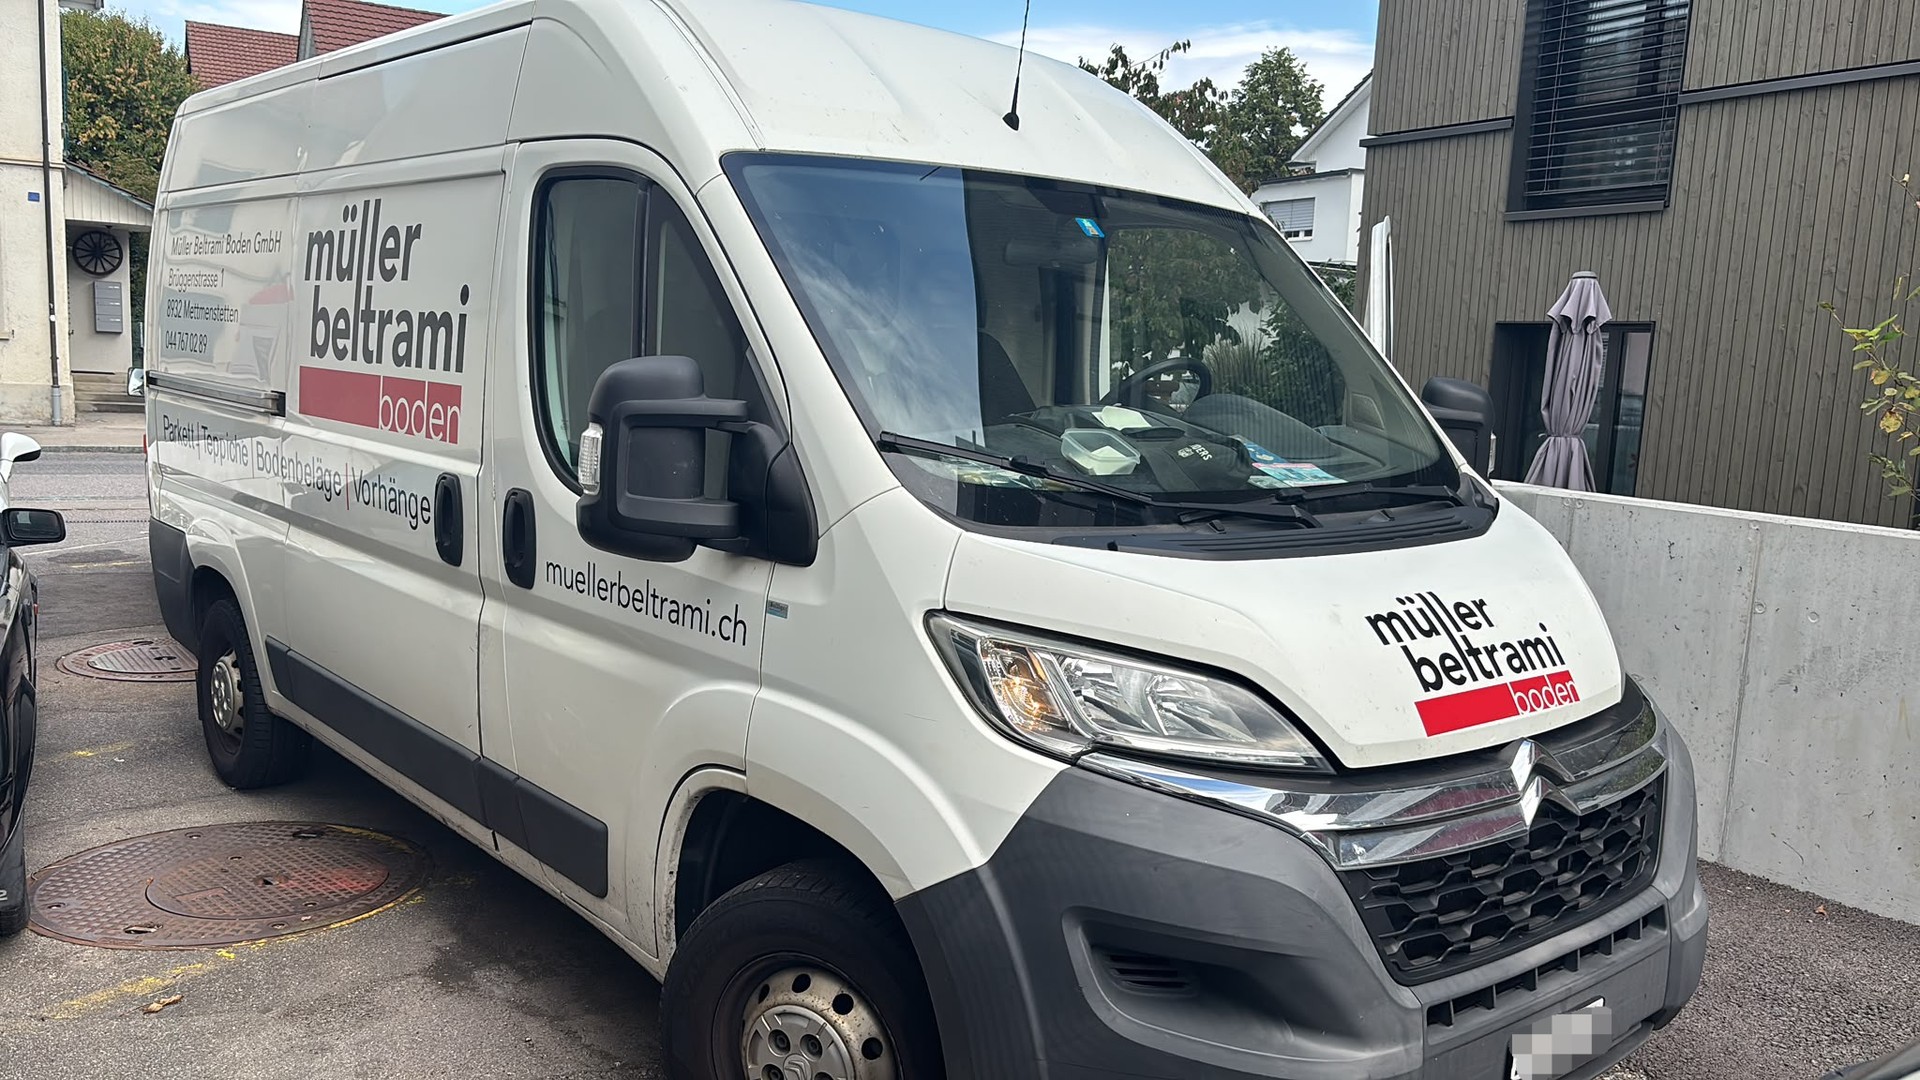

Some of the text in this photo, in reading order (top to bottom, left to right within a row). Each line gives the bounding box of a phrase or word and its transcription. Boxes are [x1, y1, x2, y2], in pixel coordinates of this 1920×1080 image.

[171, 230, 282, 255] Müller Beltrami Boden GmbH
[304, 199, 422, 282] müller
[166, 299, 239, 322] 8932 Mettmenstetten
[168, 267, 225, 292] Brüggenstrasse 1
[165, 330, 208, 353] 044 767 02 89
[310, 284, 470, 374] beltrami
[378, 375, 461, 445] boden
[163, 414, 431, 530] Parkett Teppiche Bodenbeläge Vorhänge
[546, 561, 748, 646] muellerbeltrami.ch
[1365, 591, 1495, 646] müller
[1400, 622, 1566, 693] beltrami
[1508, 674, 1579, 716] boden
